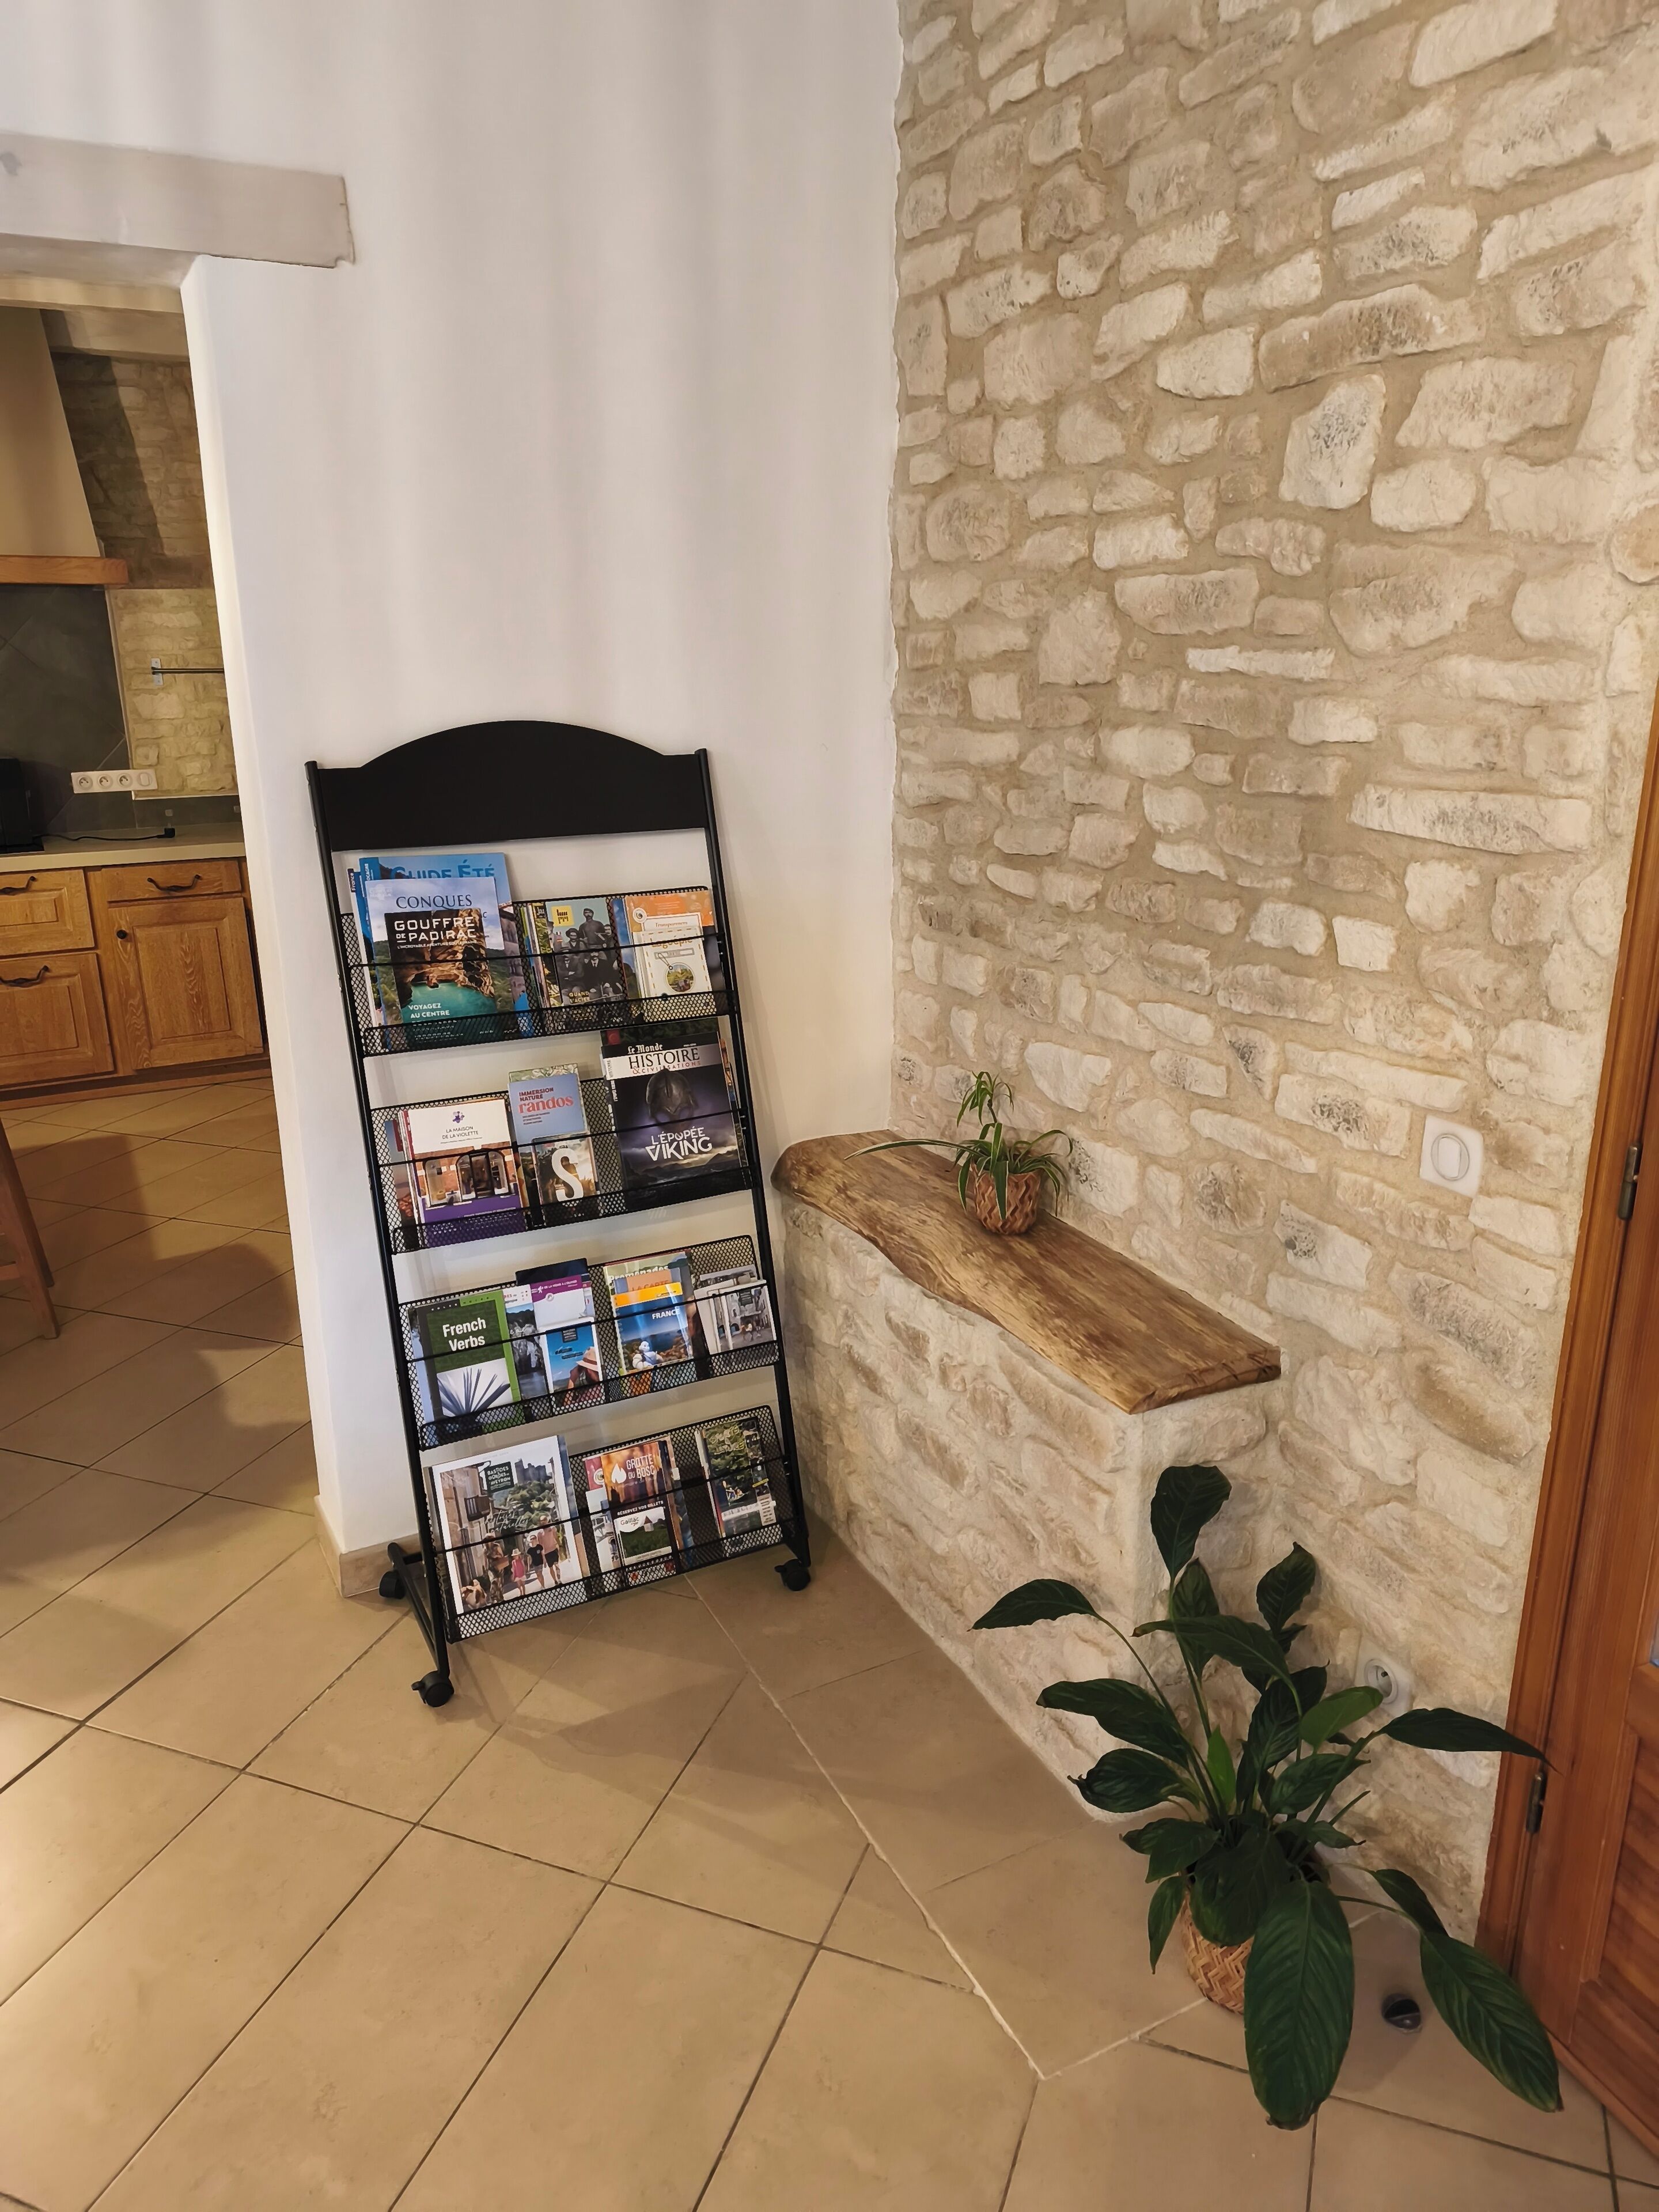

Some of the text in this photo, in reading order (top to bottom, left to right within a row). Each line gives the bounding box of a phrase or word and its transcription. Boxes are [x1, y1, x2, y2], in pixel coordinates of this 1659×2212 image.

[396, 894, 472, 910] CONQUES
[394, 916, 475, 931] GOUFFRE
[408, 929, 476, 942] PADIRAC
[422, 1010, 450, 1018] CENTRE
[627, 1043, 663, 1054] Le Monde
[628, 1048, 700, 1069] HISTOIRE
[519, 1087, 554, 1097] IMMERSION
[518, 1096, 574, 1113] randos
[651, 1126, 706, 1145] L'ÉPOPÉE
[645, 1137, 713, 1161] VIKING
[442, 1317, 486, 1338] French
[448, 1334, 486, 1351] Verbs
[626, 1454, 654, 1470] GROTTE
[636, 1465, 656, 1479] BOSC
